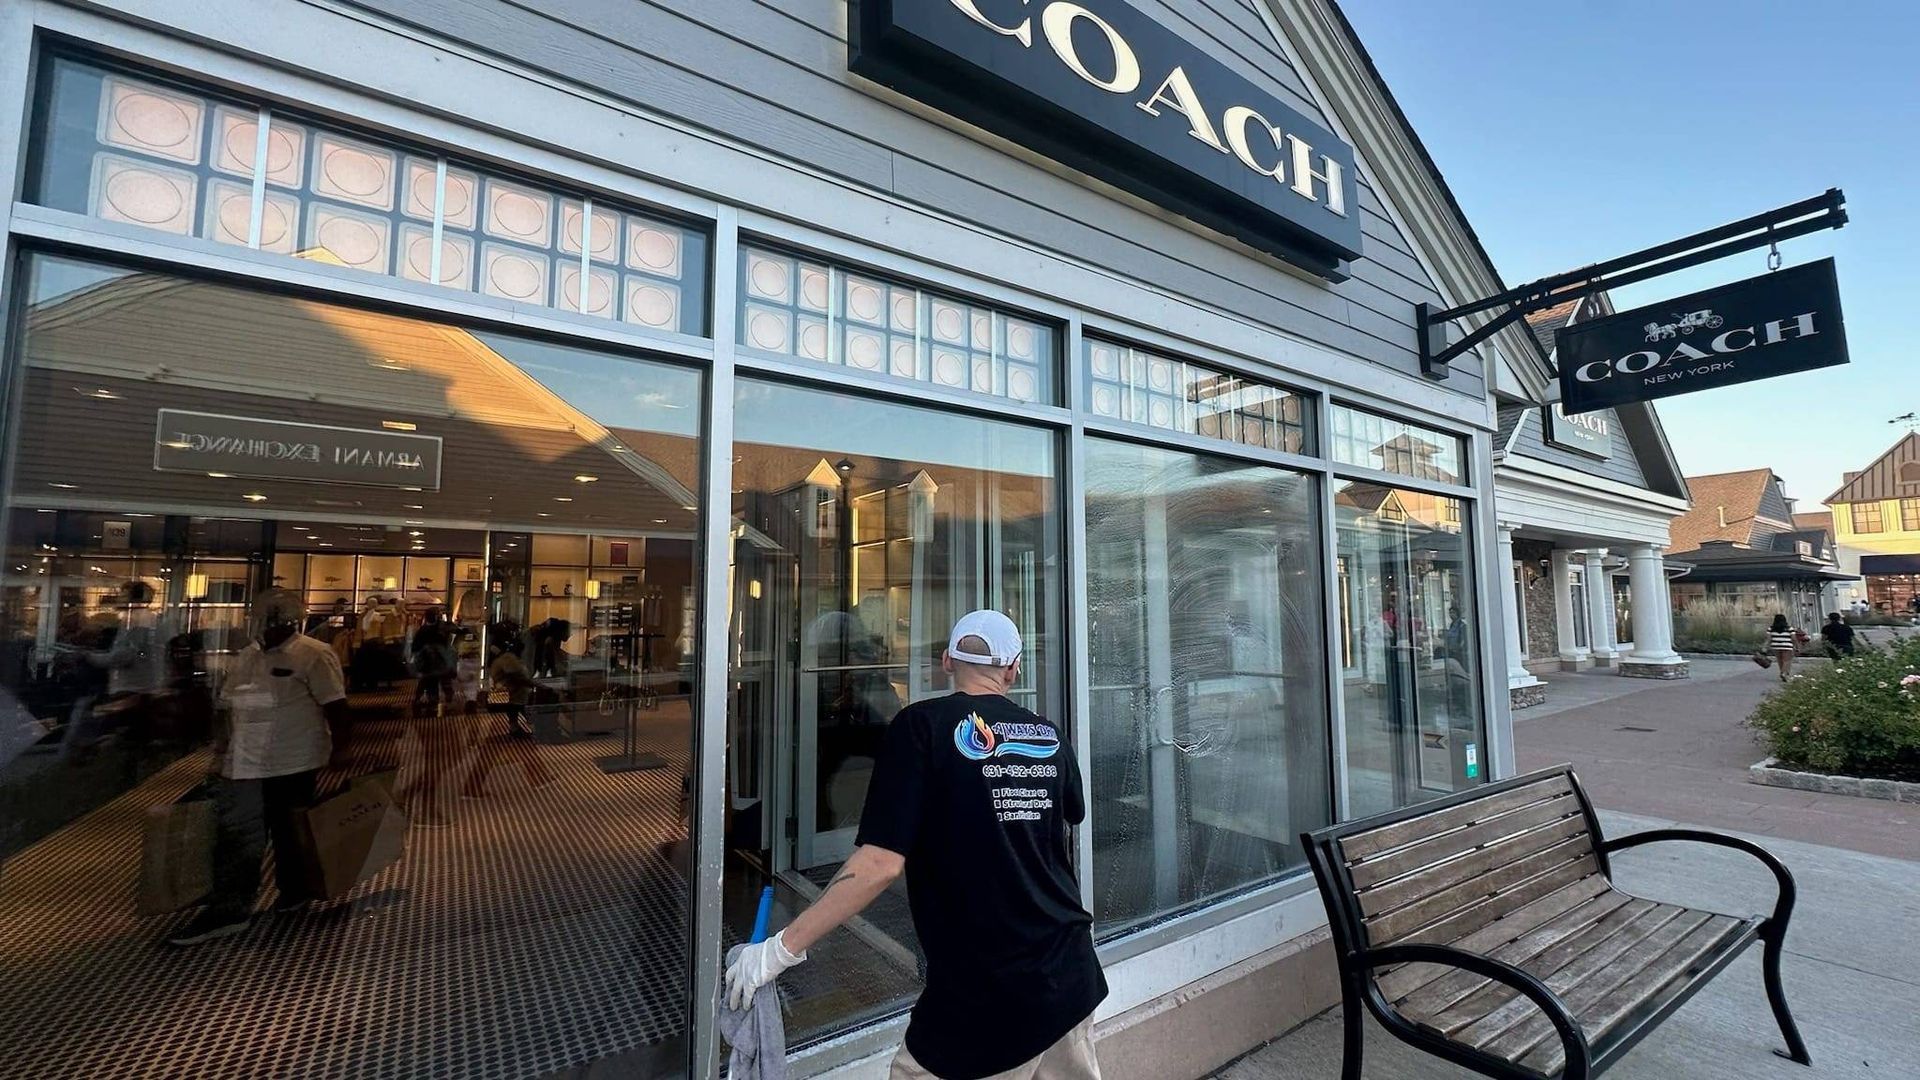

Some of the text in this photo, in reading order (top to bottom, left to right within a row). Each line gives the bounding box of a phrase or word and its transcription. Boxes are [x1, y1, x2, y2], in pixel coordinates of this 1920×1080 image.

[1576, 312, 1820, 383] COACH
[1644, 360, 1735, 386] NEW YORK
